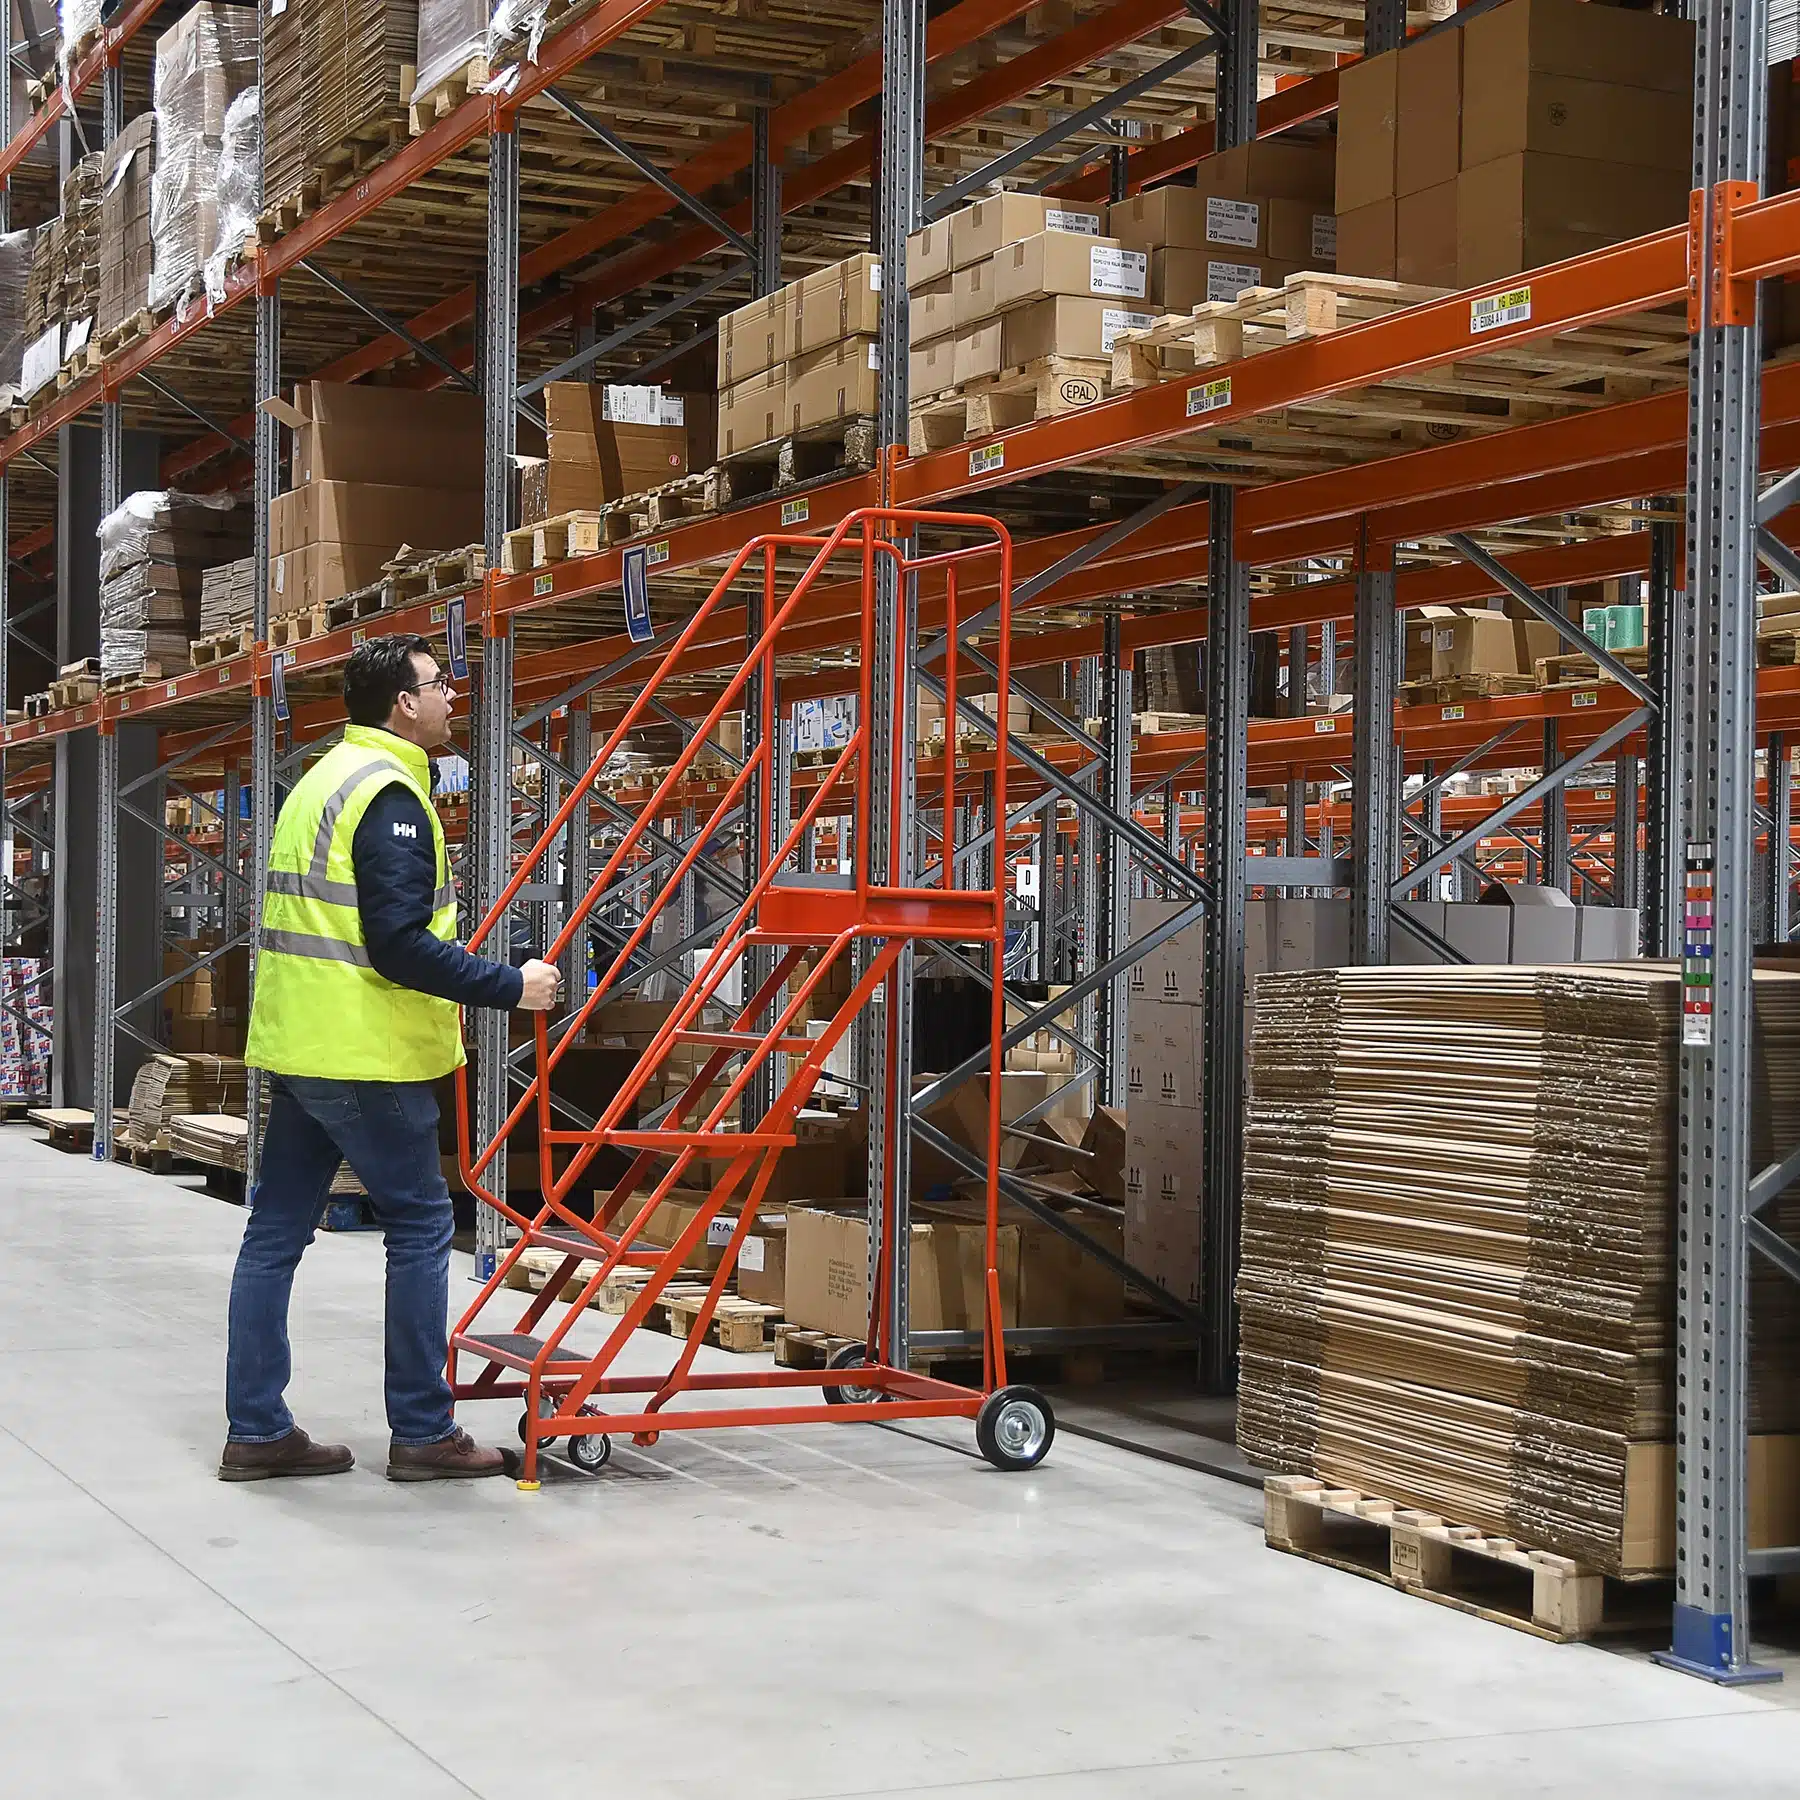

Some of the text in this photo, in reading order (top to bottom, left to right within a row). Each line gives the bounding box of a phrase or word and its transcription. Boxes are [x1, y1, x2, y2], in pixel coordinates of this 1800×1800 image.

[1314, 247, 1323, 255] 20
[1093, 278, 1103, 287] 20
[1104, 342, 1114, 350] 20
[1066, 385, 1092, 400] EPAL
[393, 822, 417, 838] HH
[1696, 860, 1702, 870] H
[1696, 889, 1703, 898] G
[1696, 917, 1701, 925] F
[1695, 946, 1701, 956] E
[1695, 974, 1700, 983] D
[1695, 1003, 1700, 1013] C
